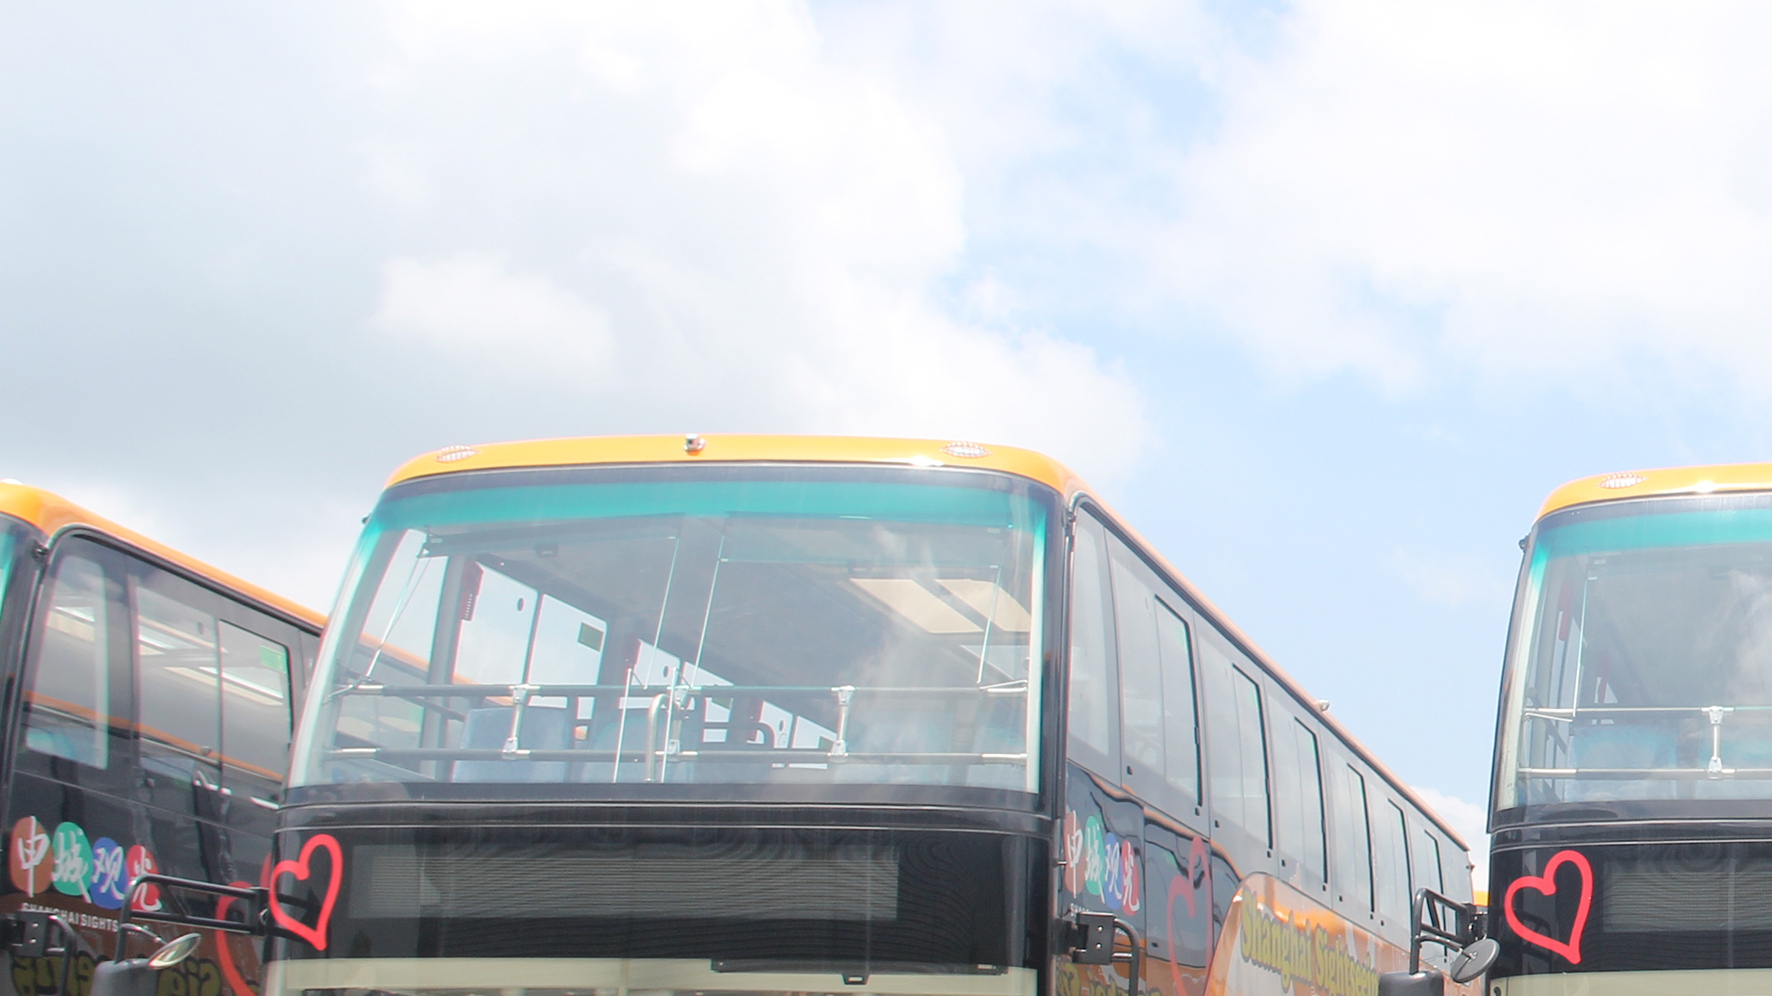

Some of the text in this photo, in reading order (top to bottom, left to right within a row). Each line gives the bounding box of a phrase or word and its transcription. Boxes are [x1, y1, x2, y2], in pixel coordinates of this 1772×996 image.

[18, 816, 163, 911] 申城观光
[1068, 810, 1140, 912] 申城观光
[1241, 885, 1313, 993] Shanghai
